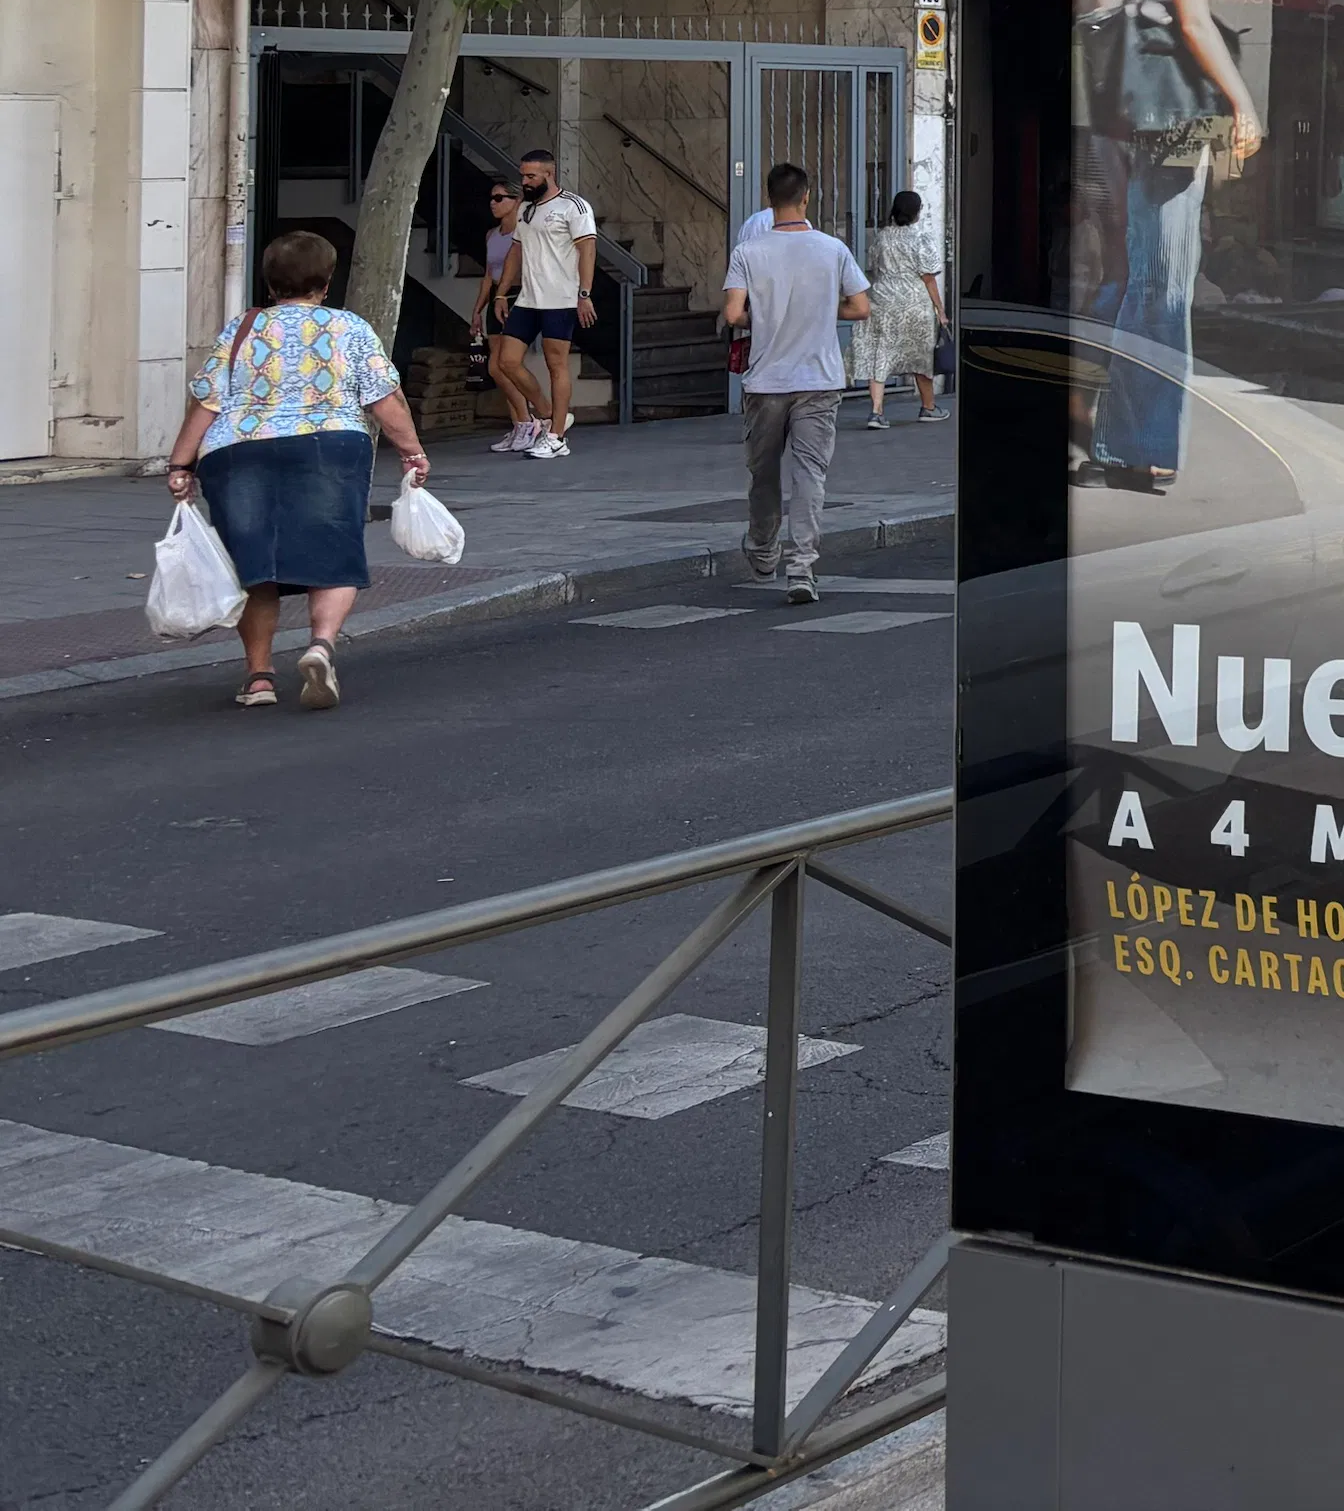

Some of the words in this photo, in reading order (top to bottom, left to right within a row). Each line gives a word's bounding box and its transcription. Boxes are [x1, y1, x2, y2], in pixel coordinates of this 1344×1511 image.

[1108, 791, 1154, 850] A
[1210, 800, 1249, 857] 4
[1106, 872, 1219, 929] LÓPEZ
[1235, 893, 1280, 936] DE
[1113, 934, 1194, 986] ESQ.
